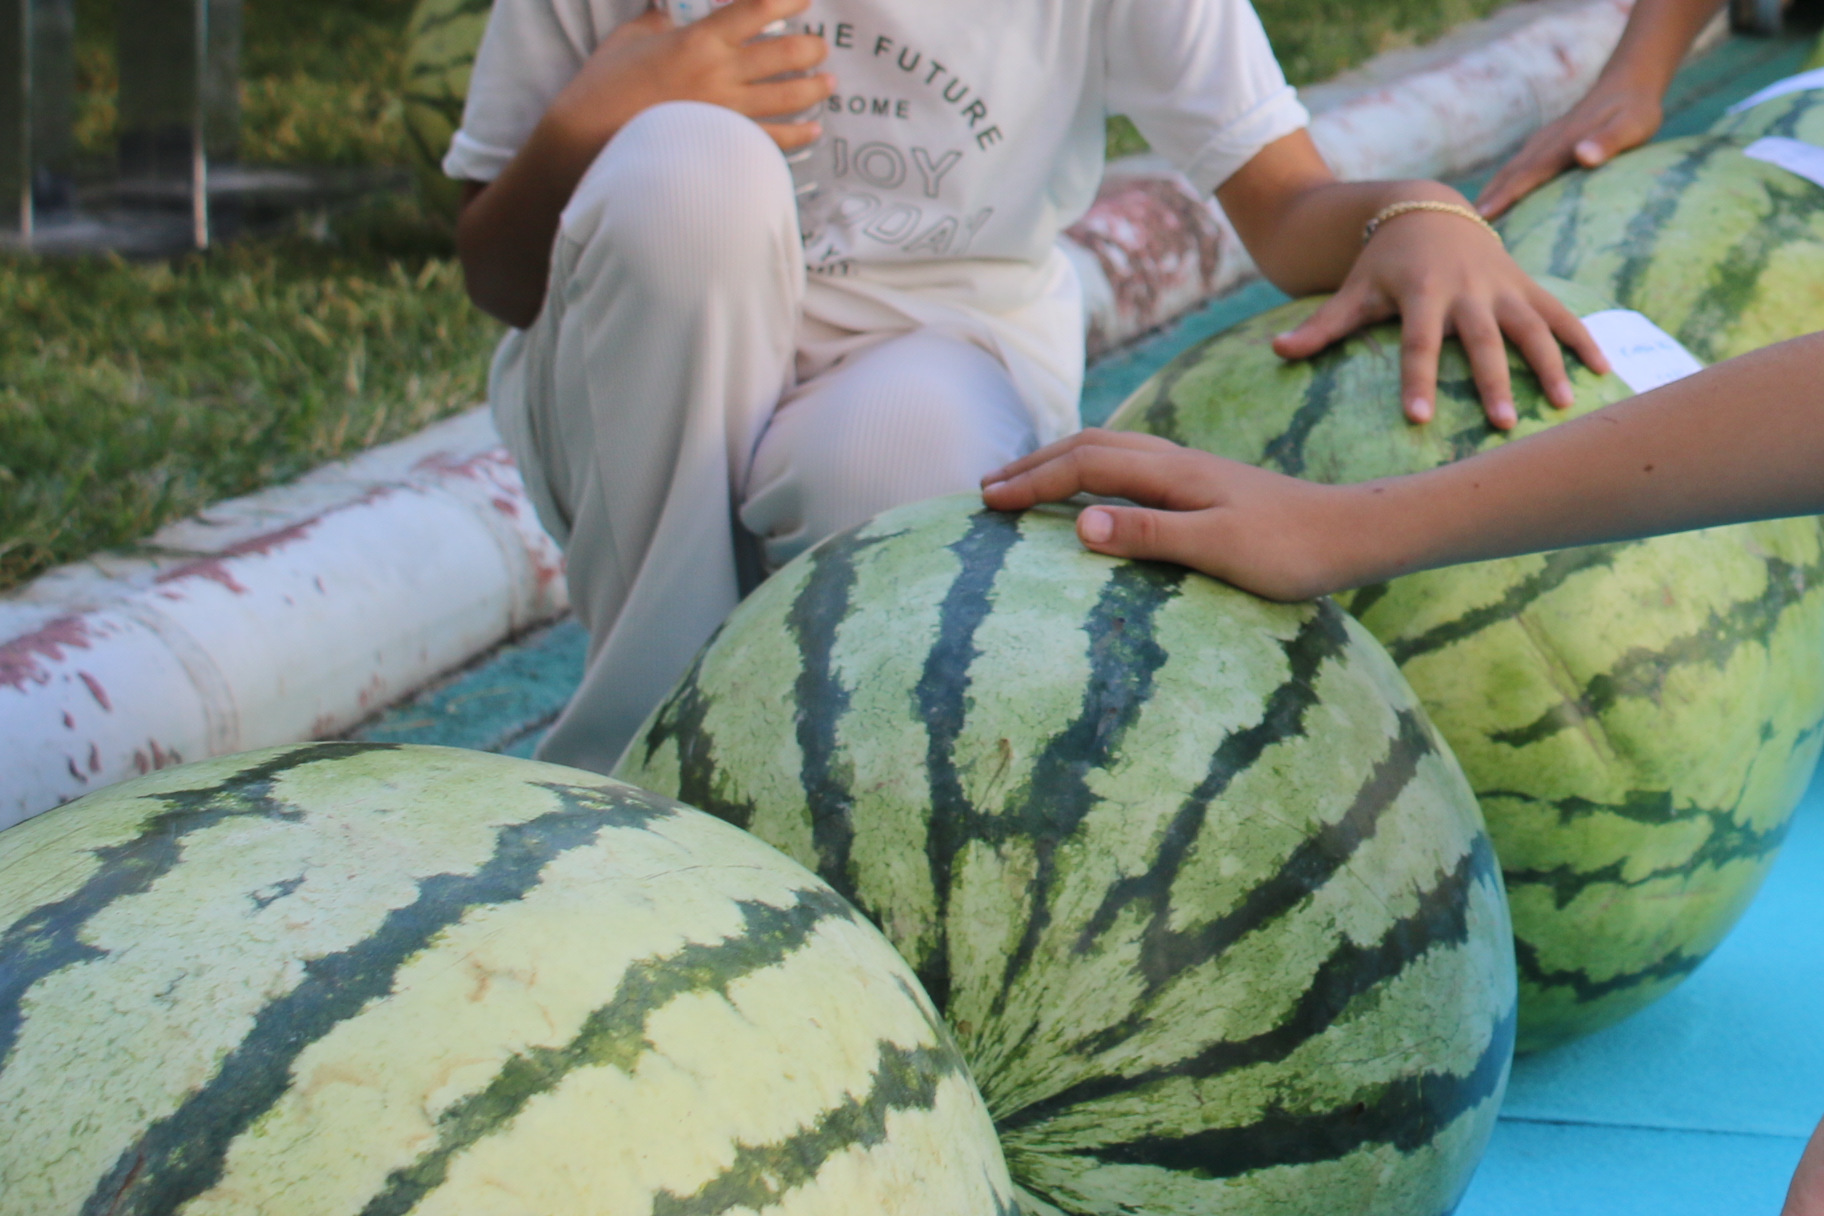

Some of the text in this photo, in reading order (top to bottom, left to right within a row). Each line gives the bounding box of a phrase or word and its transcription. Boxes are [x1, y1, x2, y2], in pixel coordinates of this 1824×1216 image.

[804, 22, 1003, 151] HE FUTURE
[828, 94, 911, 120] SOME
